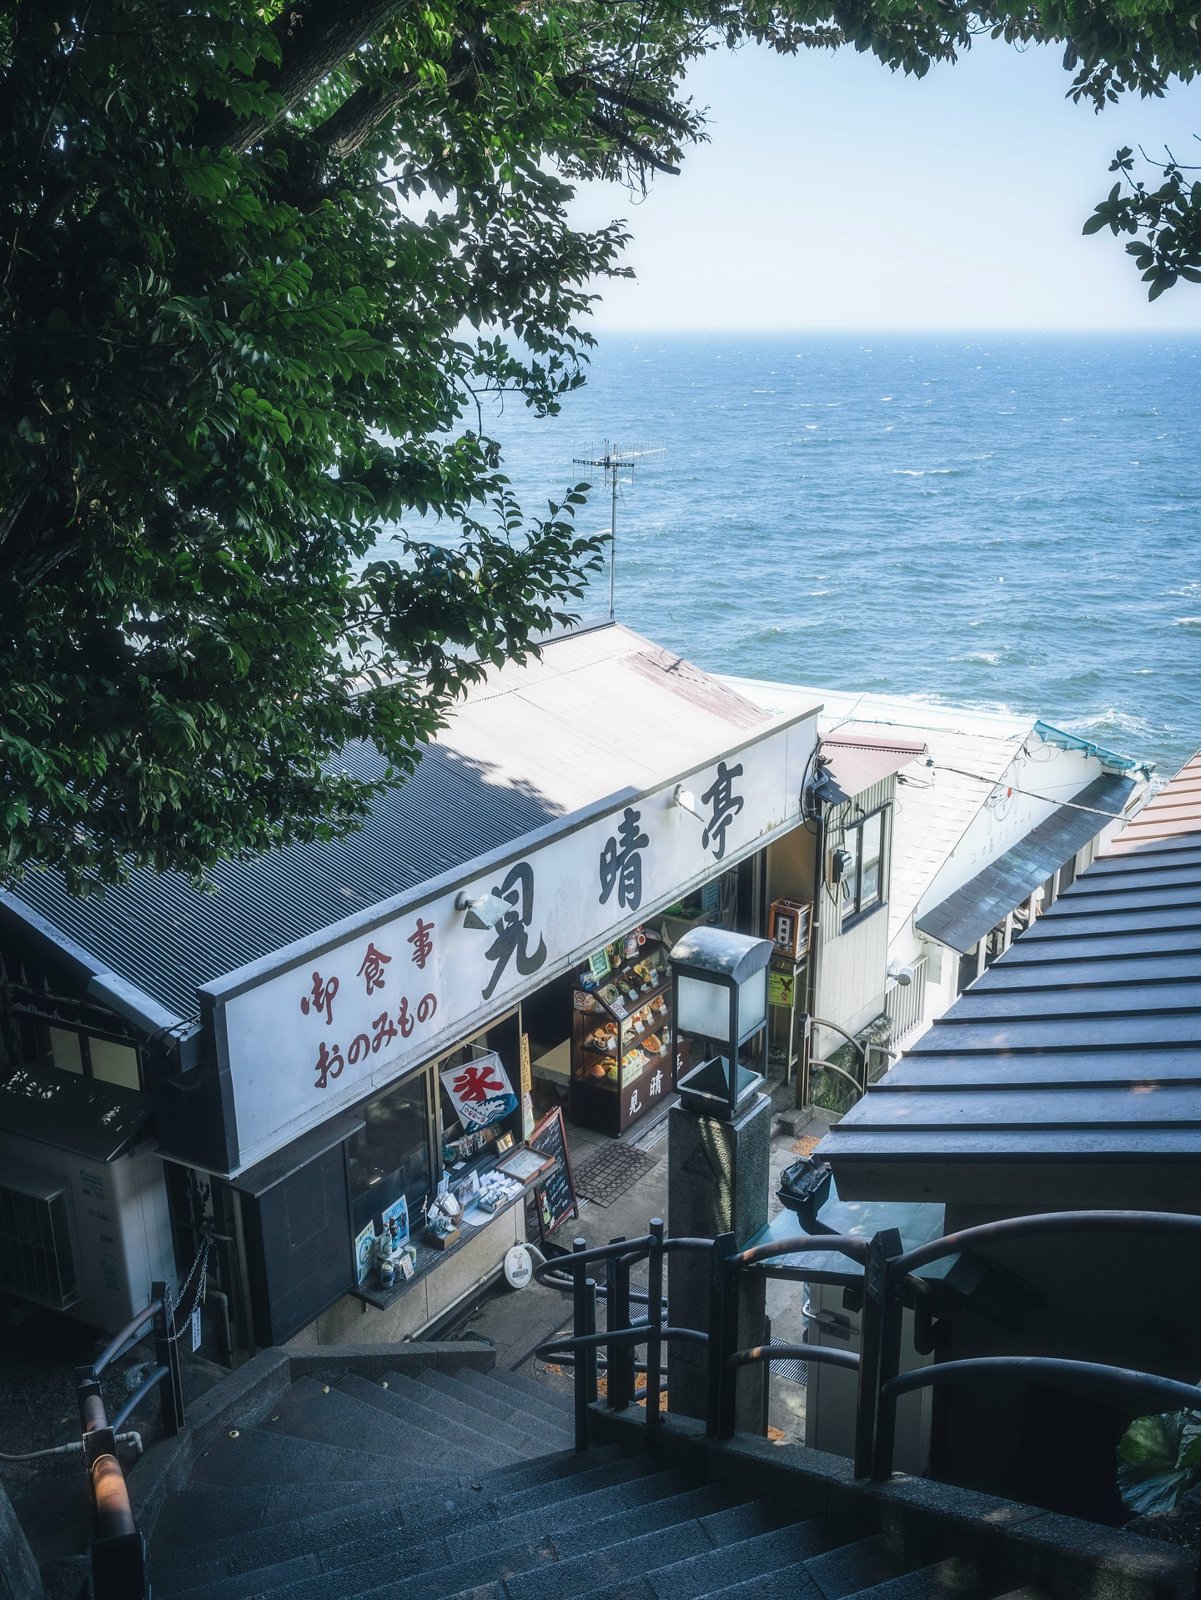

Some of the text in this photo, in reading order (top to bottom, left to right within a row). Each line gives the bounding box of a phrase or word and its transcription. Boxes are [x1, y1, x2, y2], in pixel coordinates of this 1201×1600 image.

[482, 761, 745, 1001] 見晴亭
[301, 918, 435, 1026] 御食事
[314, 993, 438, 1089] おのみもの
[452, 1066, 505, 1103] 氷
